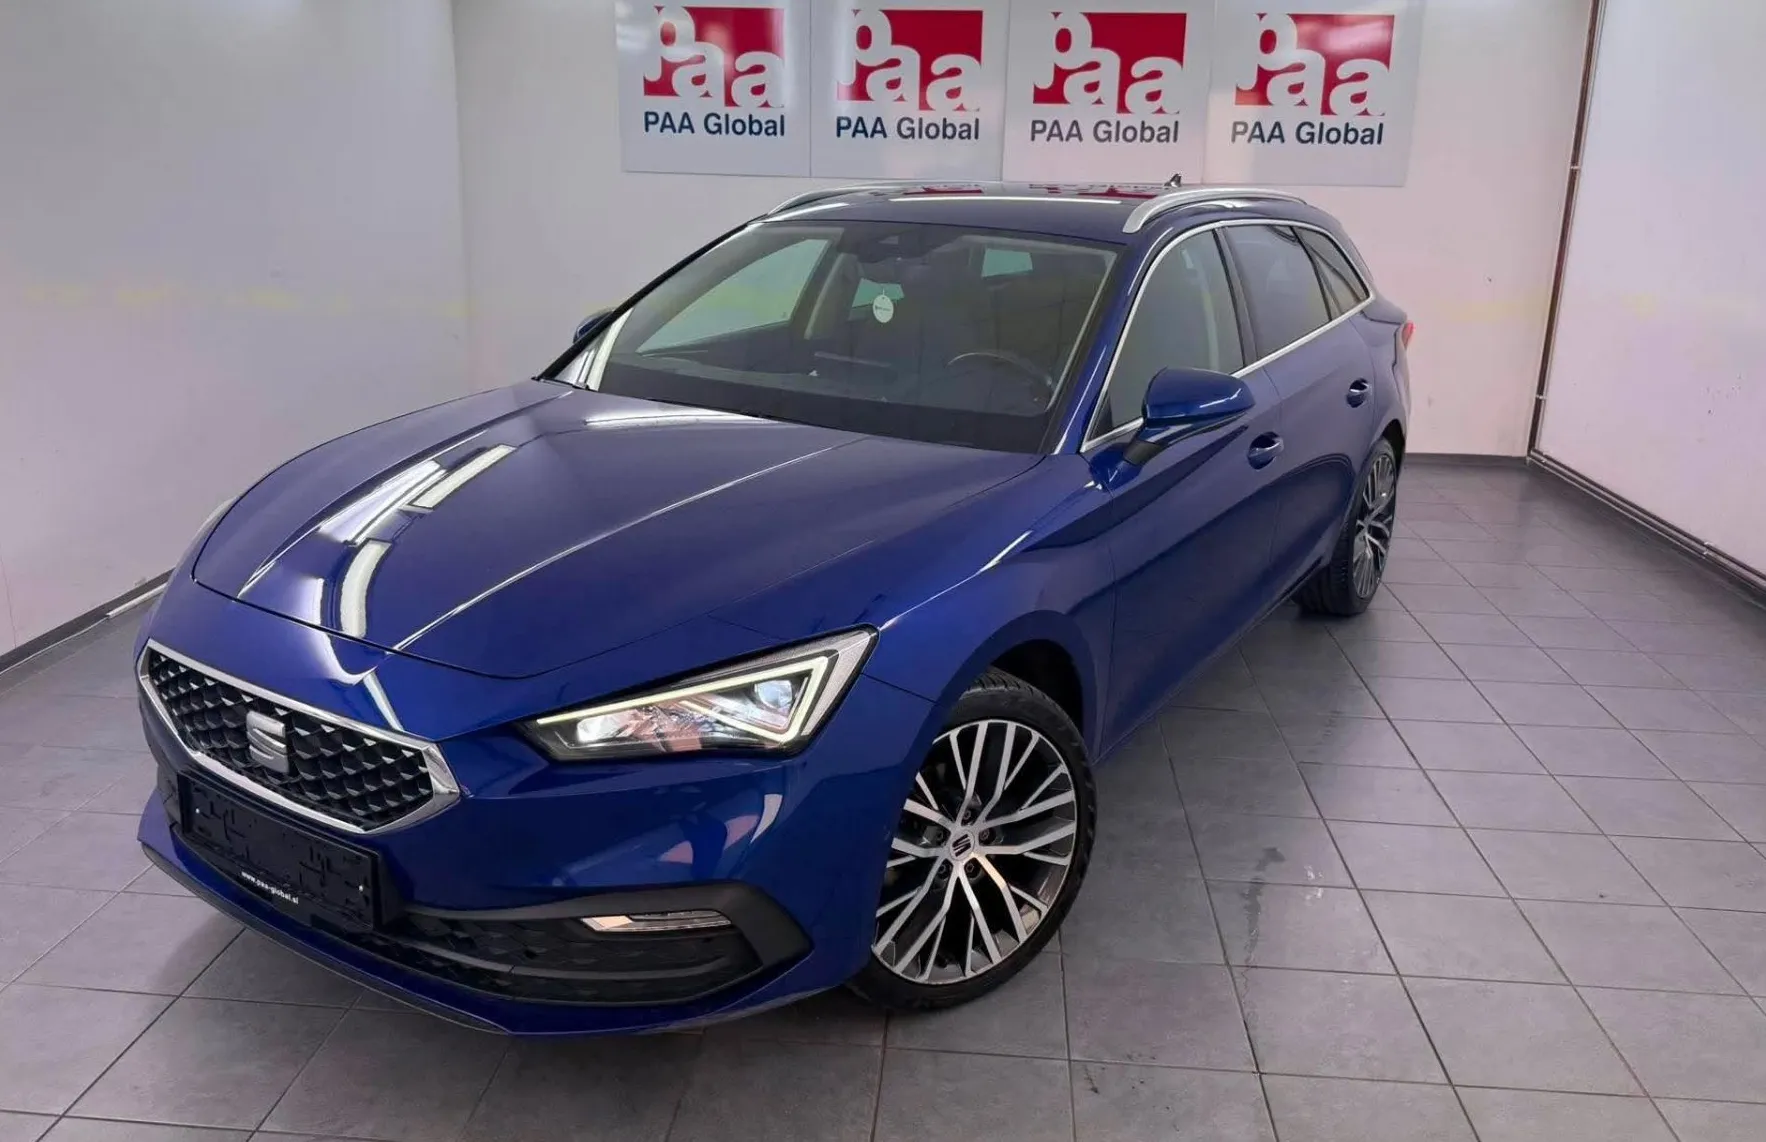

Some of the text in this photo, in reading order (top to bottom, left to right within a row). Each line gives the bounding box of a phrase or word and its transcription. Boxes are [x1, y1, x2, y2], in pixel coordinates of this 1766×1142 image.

[644, 111, 785, 137] PAA Global
[836, 116, 980, 141] PAA Global
[1030, 119, 1180, 144] PAA Global
[1231, 121, 1384, 146] PAA Global
